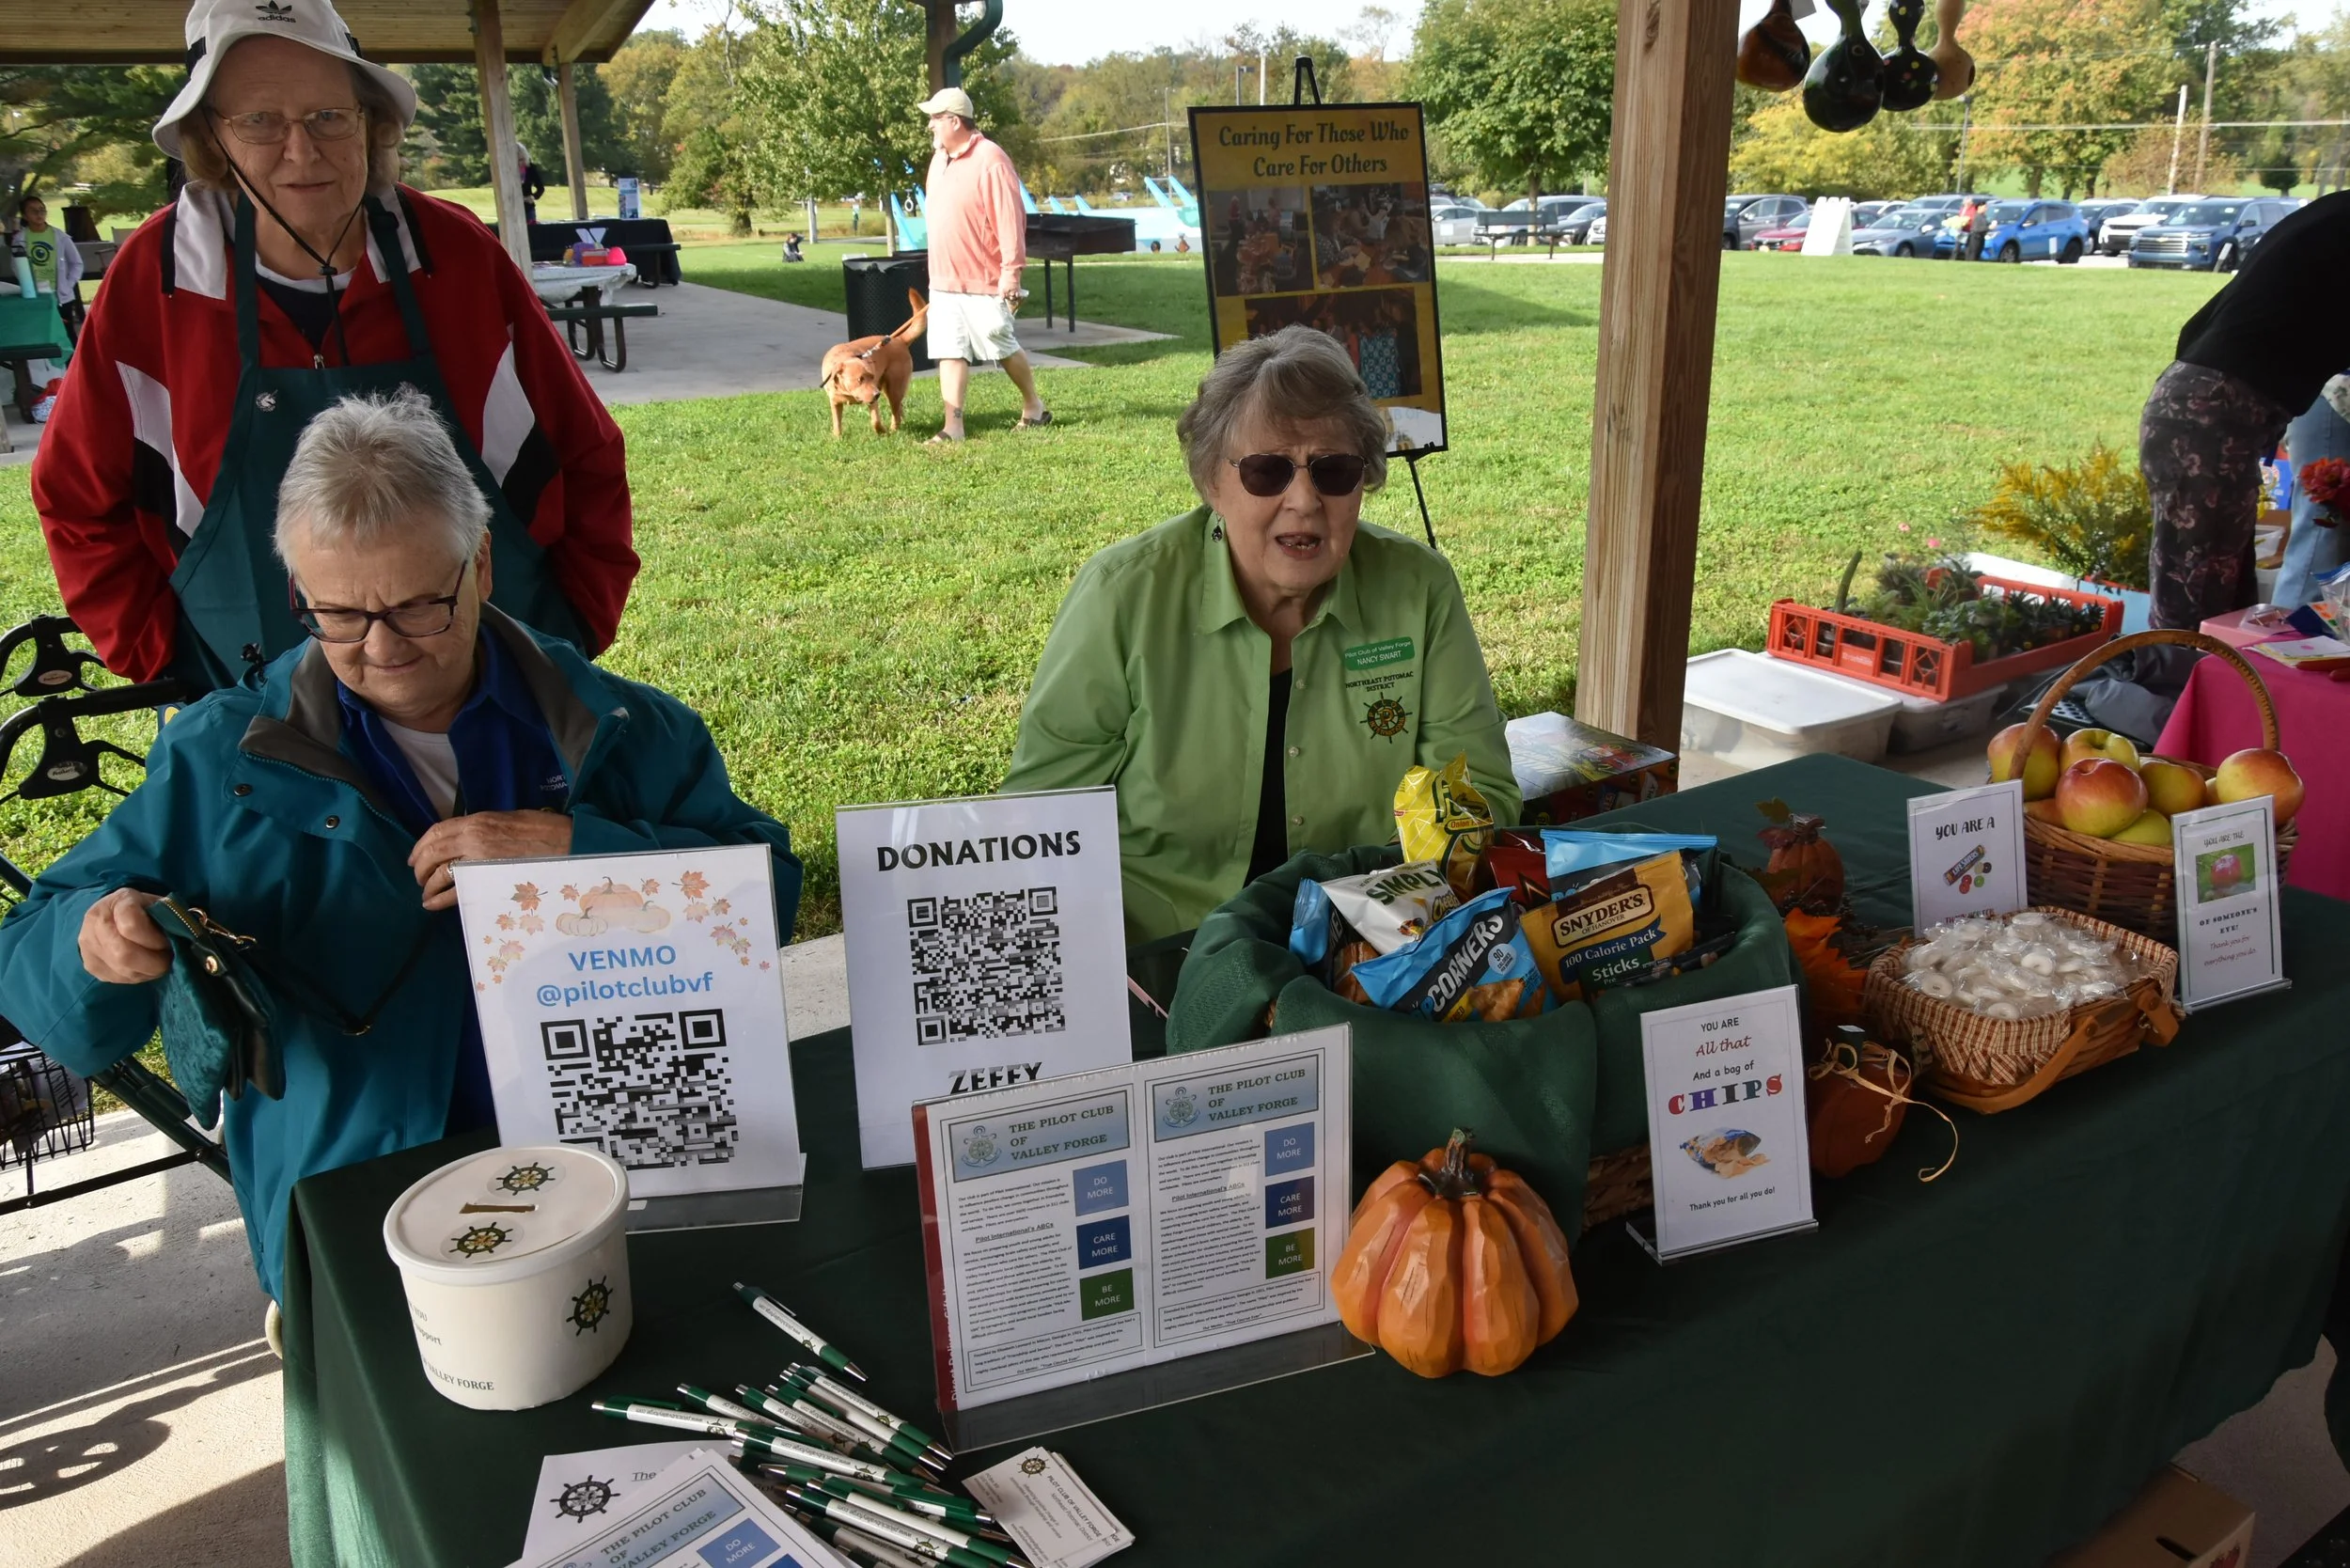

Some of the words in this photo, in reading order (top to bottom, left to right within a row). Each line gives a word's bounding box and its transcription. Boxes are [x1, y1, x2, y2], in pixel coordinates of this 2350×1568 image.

[258, 14, 296, 24] adidas
[1219, 124, 1279, 149] Caring
[1286, 124, 1313, 145] For
[1317, 121, 1365, 143] Those
[1370, 120, 1408, 141] Who
[1254, 157, 1294, 177] Care
[1300, 155, 1327, 175] For
[1331, 153, 1387, 174] Others
[1357, 655, 1378, 666] NANCY
[1380, 651, 1402, 661] SWART
[1345, 677, 1382, 688] NORTHEAST
[1384, 671, 1414, 682] POTOMAC
[1367, 682, 1395, 692] DISTRICT
[1935, 823, 1957, 840] YOU
[1962, 818, 1983, 834] ARE
[1987, 817, 1995, 828] A
[2203, 838, 2217, 848] YOU
[2218, 834, 2231, 843] ARE
[2232, 831, 2245, 839] THE
[877, 830, 1081, 871] DONATIONS
[1366, 869, 1447, 905] SIMPLY
[1559, 893, 1645, 936] SNYDER'S
[2213, 907, 2258, 923] SOMEONE'S
[1581, 927, 1591, 935] OF
[1591, 914, 1625, 932] HANOVER
[2220, 925, 2239, 933] EYE!
[1565, 953, 1582, 967] 100
[1585, 942, 1627, 960] Calorie
[1629, 928, 1656, 948] Pack
[2210, 941, 2229, 950] Thank
[2230, 938, 2241, 948] you
[568, 945, 677, 971] VENMO
[1493, 949, 1504, 961] 90
[1592, 957, 1640, 981] Sticks
[537, 971, 713, 1007] @pilotclubvf
[1700, 1021, 1719, 1032] YOU
[1720, 1017, 1740, 1029] ARE
[1695, 1041, 1718, 1057] All
[1718, 1035, 1752, 1053] that
[948, 1061, 1042, 1095] ZEFFY
[1693, 1069, 1711, 1081] And
[1715, 1069, 1720, 1077] a
[1724, 1064, 1741, 1078] bag
[1744, 1060, 1755, 1071] of
[1208, 1081, 1236, 1095] THE
[1237, 1074, 1271, 1090] PILOT
[1274, 1068, 1306, 1084] CLUB
[1668, 1074, 1782, 1115] CHIPS
[1208, 1098, 1226, 1108] OF
[1208, 1105, 1255, 1122] VALLEY
[1256, 1095, 1298, 1114] FORGE
[1008, 1119, 1036, 1134] THE
[1039, 1112, 1077, 1129] PILOT
[1080, 1105, 1114, 1121] CLUB
[1010, 1137, 1027, 1148] OF
[1010, 1144, 1061, 1161] VALLEY
[1063, 1134, 1107, 1152] FORGE
[1283, 1137, 1296, 1147] DO
[1277, 1147, 1302, 1159] MORE
[1093, 1176, 1107, 1186] DO
[1087, 1184, 1114, 1200] MORE
[1171, 1194, 1185, 1202] Pilot
[1186, 1186, 1227, 1199] International's
[1279, 1192, 1302, 1204] CARE
[1689, 1200, 1711, 1212] Thank
[1713, 1198, 1726, 1208] you
[1727, 1195, 1737, 1204] for
[1739, 1192, 1748, 1201] all
[1750, 1190, 1762, 1200] you
[1763, 1186, 1776, 1197] do!
[1277, 1203, 1303, 1216] MORE
[976, 1235, 990, 1244] Pilot
[992, 1227, 1035, 1241] International's
[1037, 1222, 1054, 1231] ABCs
[1093, 1231, 1116, 1245] CARE
[1091, 1244, 1119, 1258] MORE
[1285, 1243, 1295, 1253] BE
[1277, 1253, 1303, 1266] MORE
[1102, 1284, 1113, 1294] BE
[1094, 1294, 1121, 1307] MORE
[457, 1377, 494, 1390] FORGE
[728, 1403, 743, 1414] CLUB
[742, 1408, 757, 1419] PILOT
[782, 1409, 797, 1421] CLUB
[794, 1416, 809, 1428] PILOT
[631, 1470, 657, 1482] The
[1046, 1474, 1059, 1488] PILOT
[1057, 1486, 1070, 1500] CLUB
[1072, 1504, 1089, 1522] VALLEY
[1085, 1519, 1102, 1538] FORGE
[601, 1536, 630, 1556] THE
[632, 1512, 669, 1538] PILOT
[672, 1488, 707, 1512] CLUB
[671, 1510, 716, 1542] FORGE
[726, 1539, 742, 1552] DO
[610, 1549, 628, 1564] OF
[726, 1543, 756, 1565] MORE
